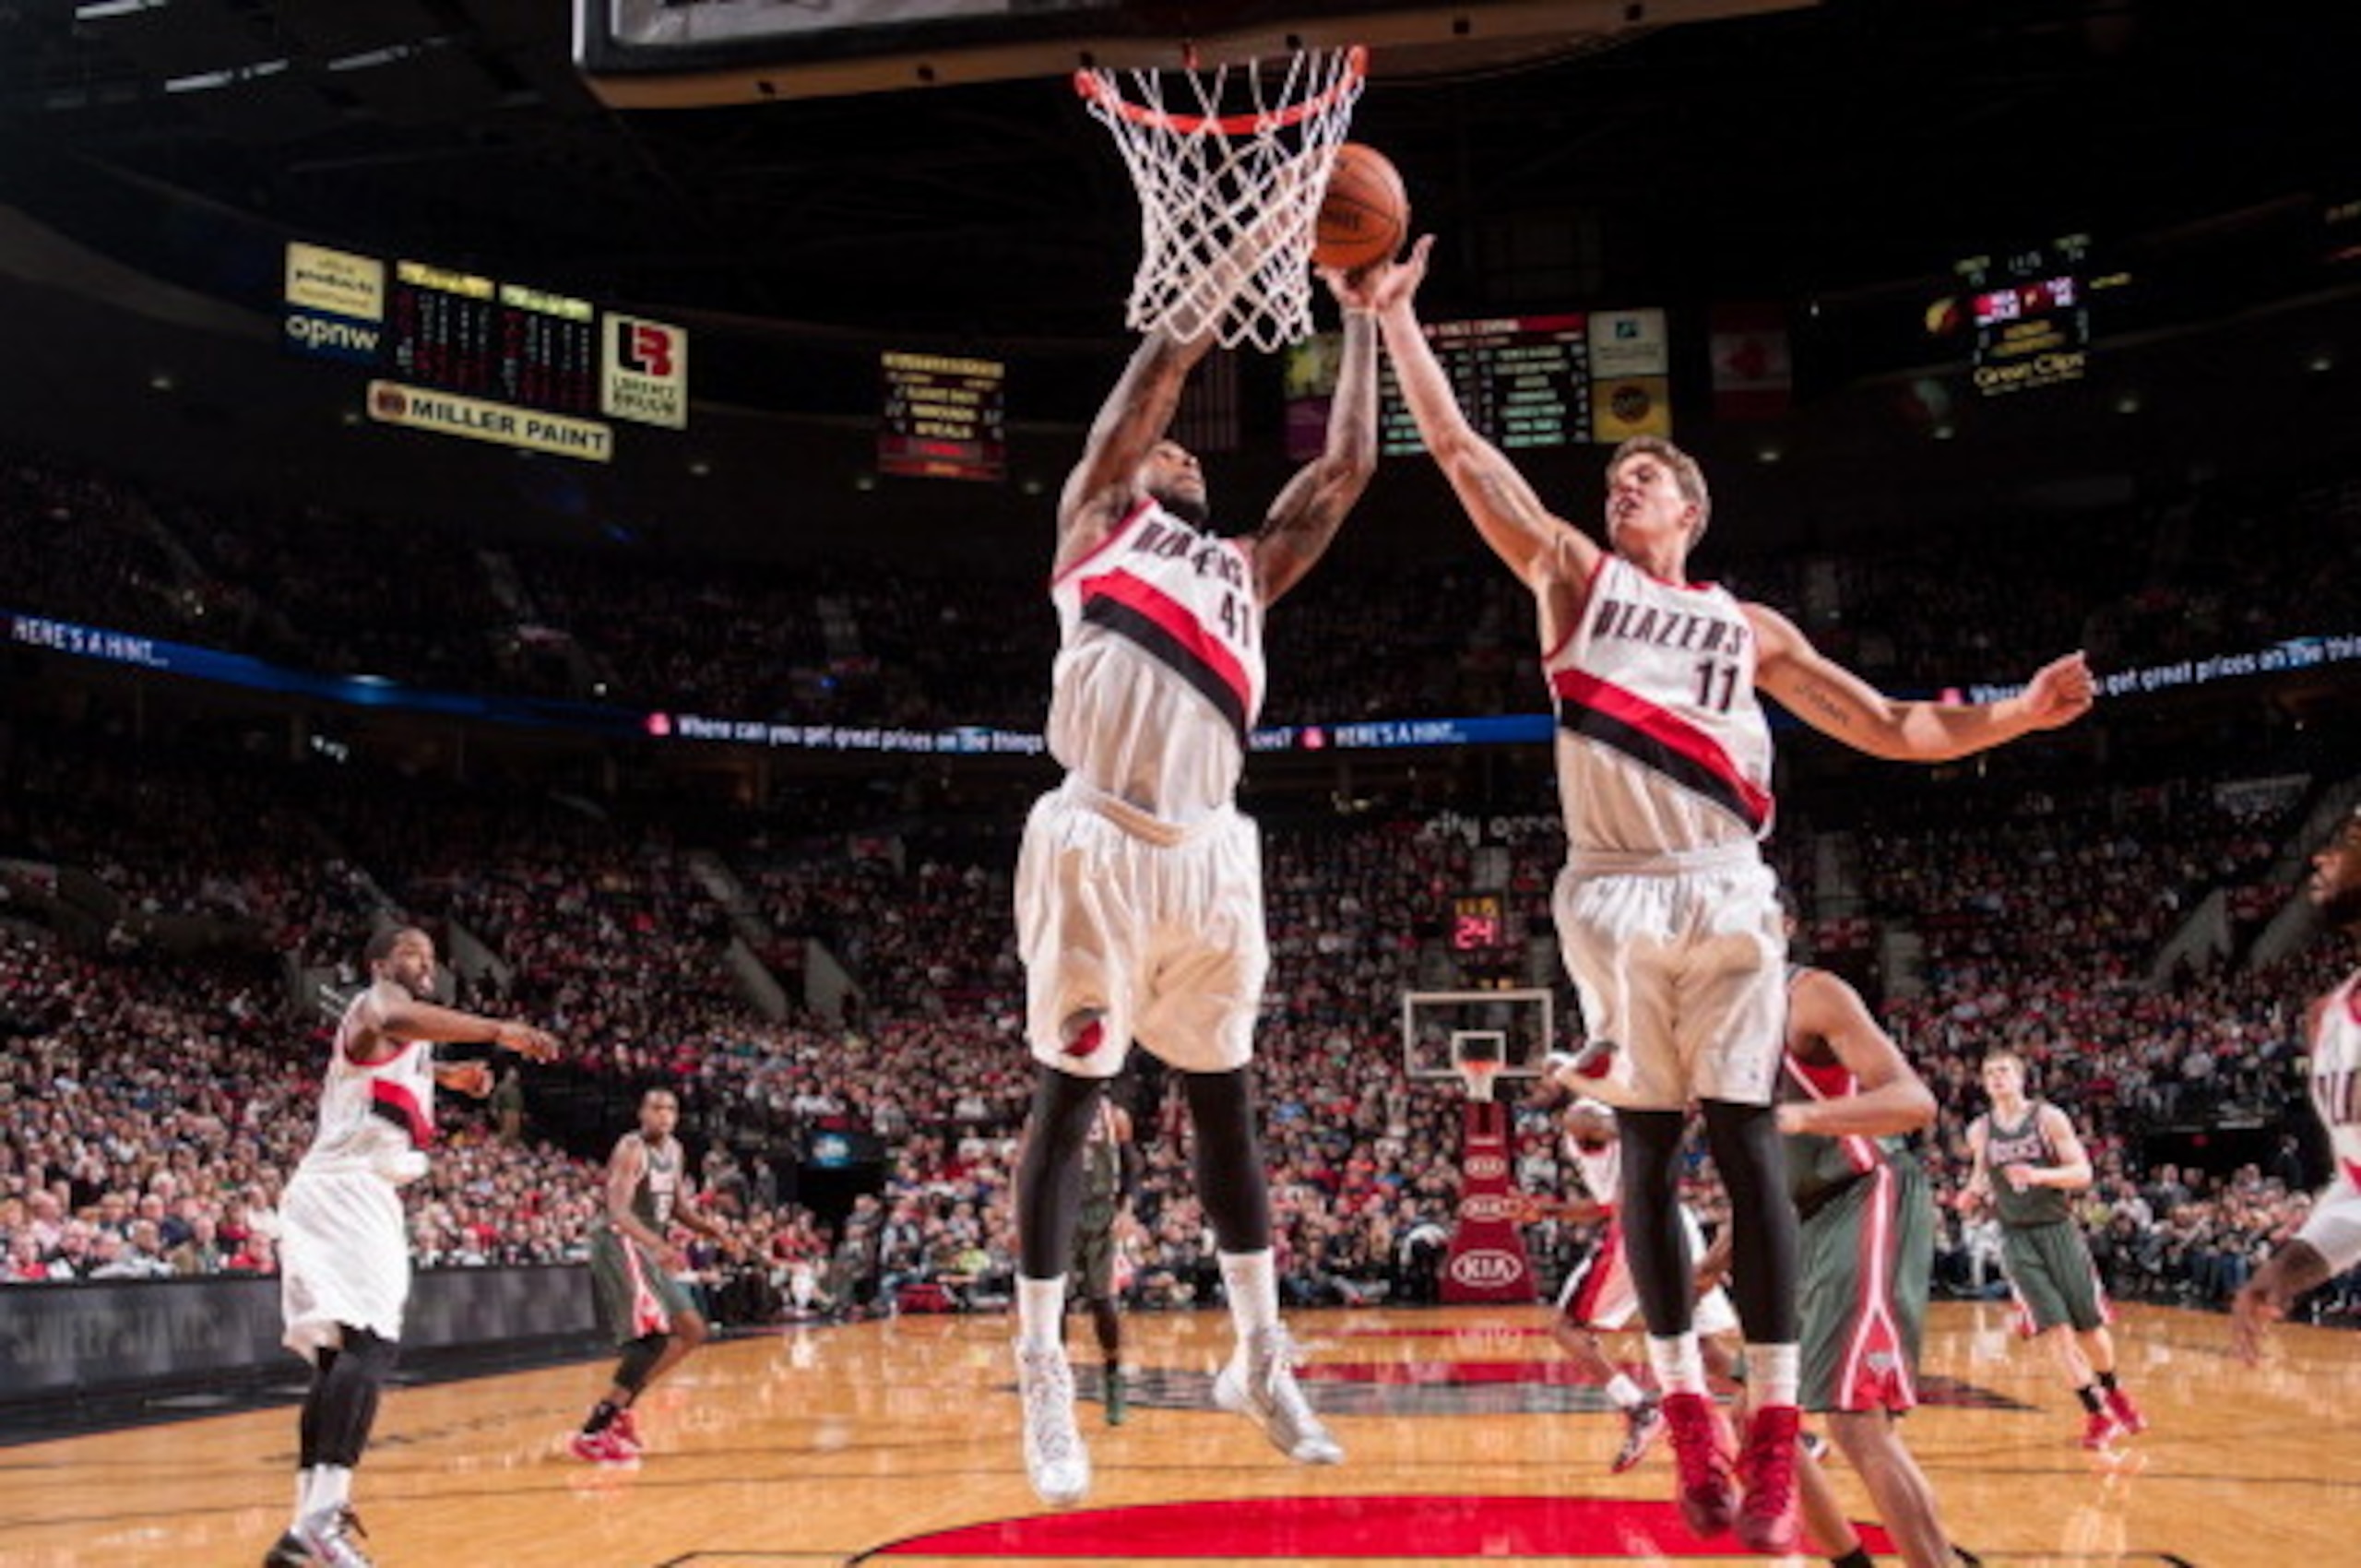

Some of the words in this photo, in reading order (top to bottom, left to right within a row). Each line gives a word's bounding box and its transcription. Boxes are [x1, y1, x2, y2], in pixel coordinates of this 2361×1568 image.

[285, 314, 381, 350] opnw
[412, 398, 516, 436] MILLER
[526, 419, 605, 452] PAINT
[1217, 587, 1253, 649] 41
[1591, 600, 1750, 657] BLAZERS
[88, 631, 103, 656] A
[1695, 657, 1740, 714] 11
[677, 714, 732, 739] Where
[735, 720, 768, 740] can
[769, 725, 801, 748] you
[803, 725, 833, 749] get
[834, 727, 880, 752] great
[881, 727, 932, 754] prices
[1396, 722, 1412, 744] A
[1454, 916, 1493, 950] 24
[1463, 1257, 1513, 1281] KIA
